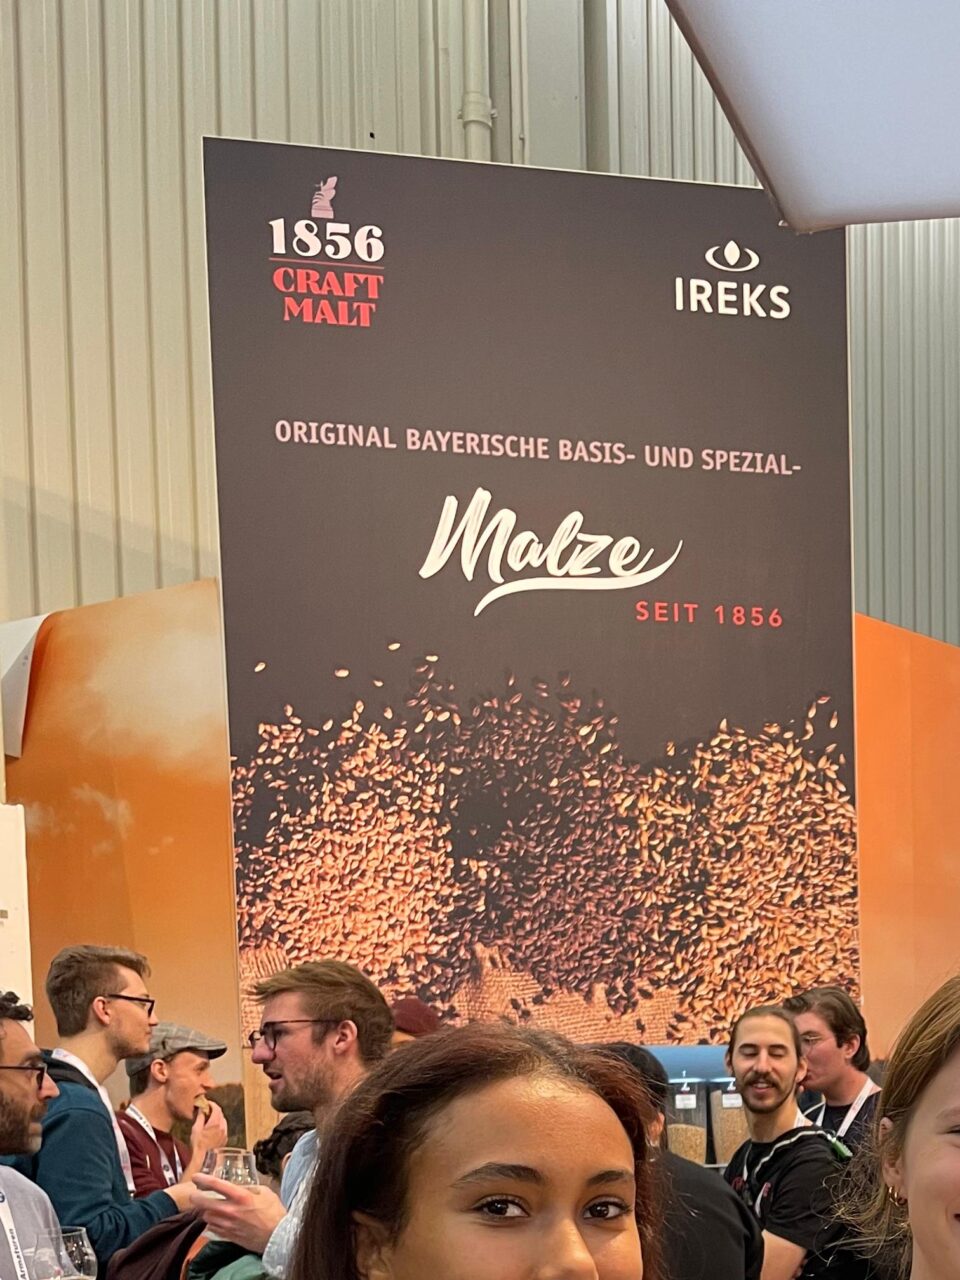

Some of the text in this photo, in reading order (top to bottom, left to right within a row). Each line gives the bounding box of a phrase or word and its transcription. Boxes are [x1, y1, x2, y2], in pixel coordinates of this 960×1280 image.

[268, 217, 385, 263] 1856
[272, 266, 384, 300] CRAFT
[675, 277, 791, 320] IREKS
[283, 296, 376, 328] MALT
[275, 419, 802, 477] ORIGINAL BAYERISCHE BASIS- UND SPEZIAL-
[418, 487, 683, 617] Malze
[636, 601, 783, 628] SEIT 1856
